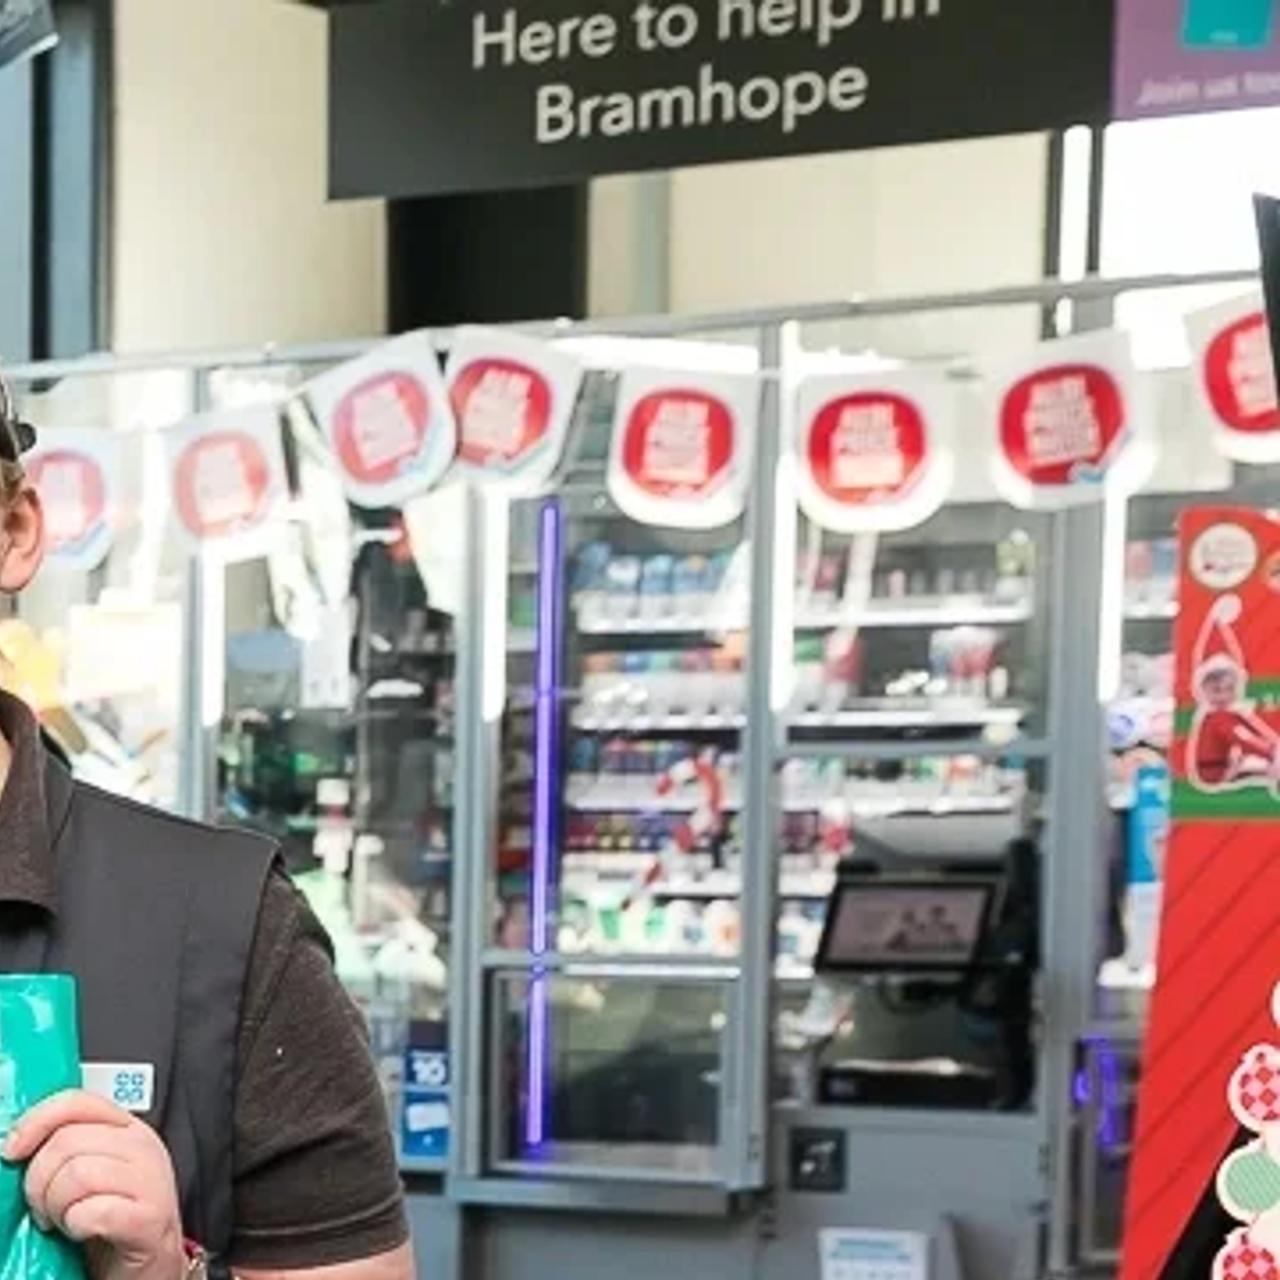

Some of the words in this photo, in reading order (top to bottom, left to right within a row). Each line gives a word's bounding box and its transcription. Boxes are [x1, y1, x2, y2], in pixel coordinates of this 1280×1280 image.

[472, 9, 618, 68] Here
[632, 2, 698, 51] to
[717, 0, 860, 47] help
[536, 63, 869, 143] Bramhope
